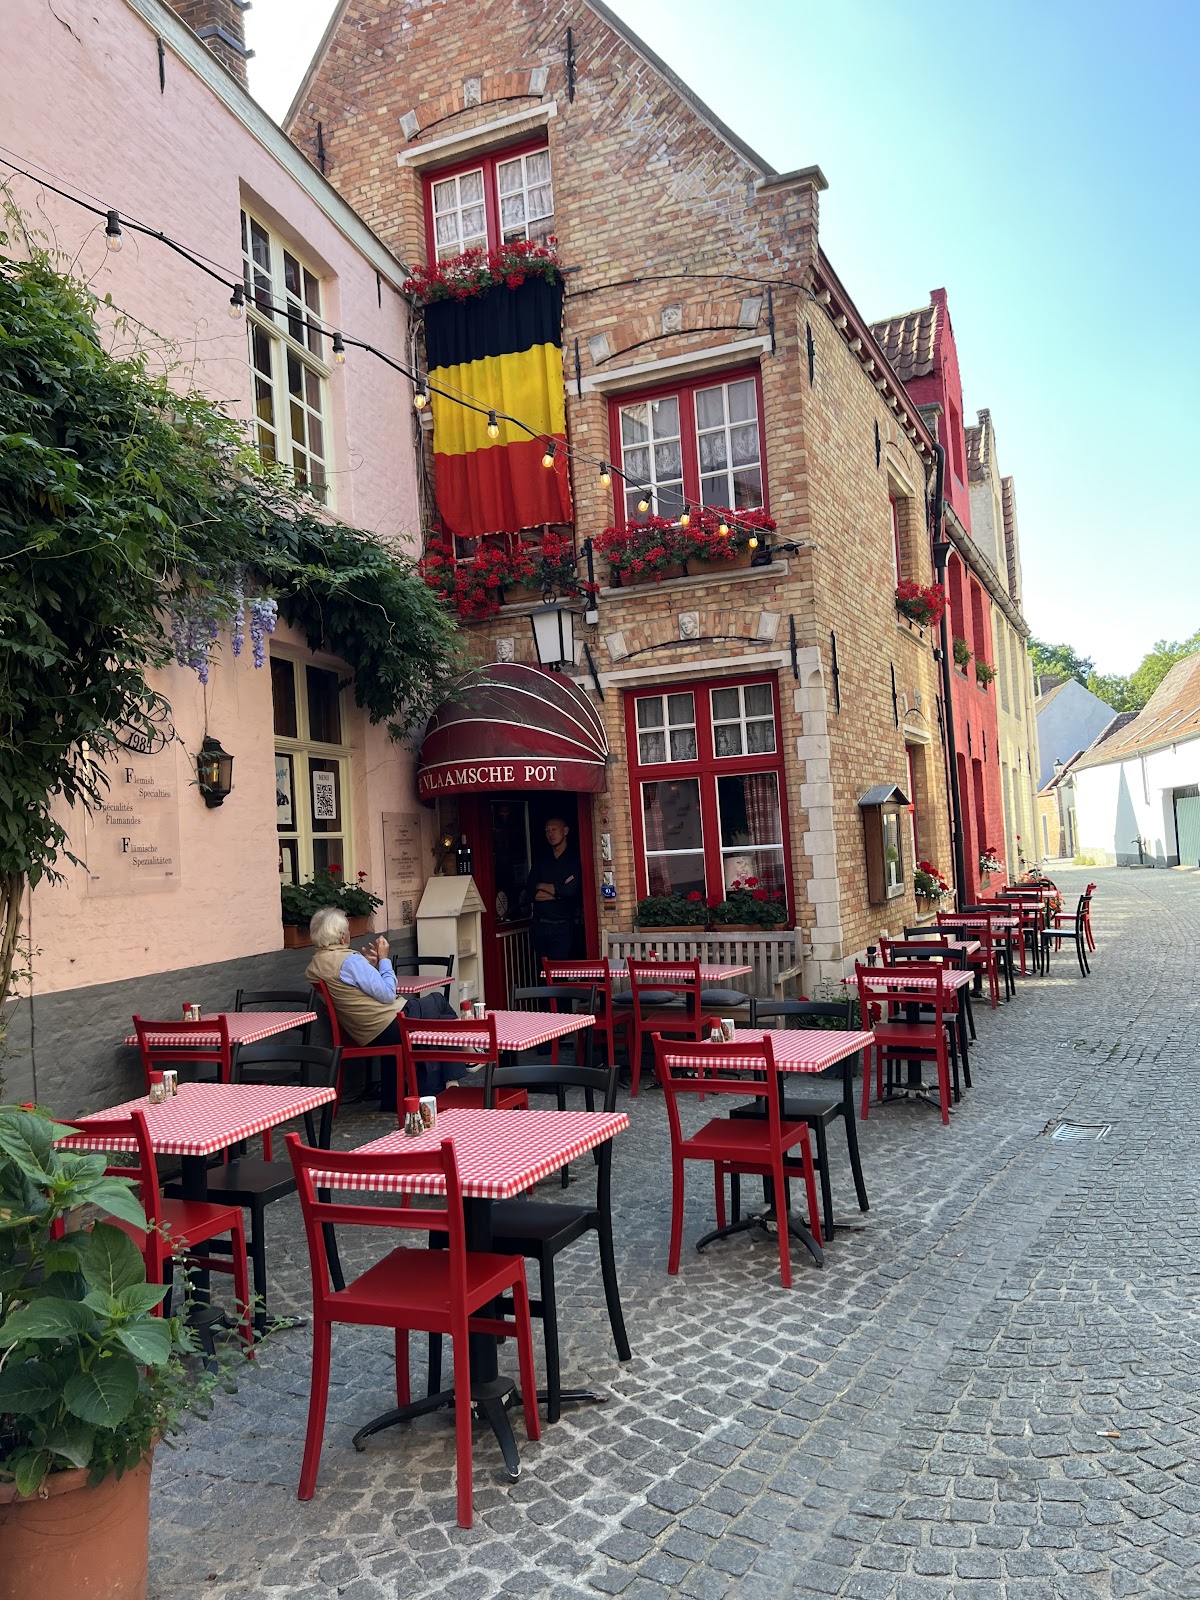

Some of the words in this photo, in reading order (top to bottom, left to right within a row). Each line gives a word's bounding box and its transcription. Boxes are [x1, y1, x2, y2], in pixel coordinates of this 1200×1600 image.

[125, 768, 155, 785] Flemish
[424, 766, 515, 789] VLAAMSCHE
[524, 766, 557, 781] POT
[139, 788, 171, 798] Specialties
[105, 815, 141, 824] Flamandes
[121, 837, 158, 853] Flämische
[132, 856, 172, 867] Spezialitäten
